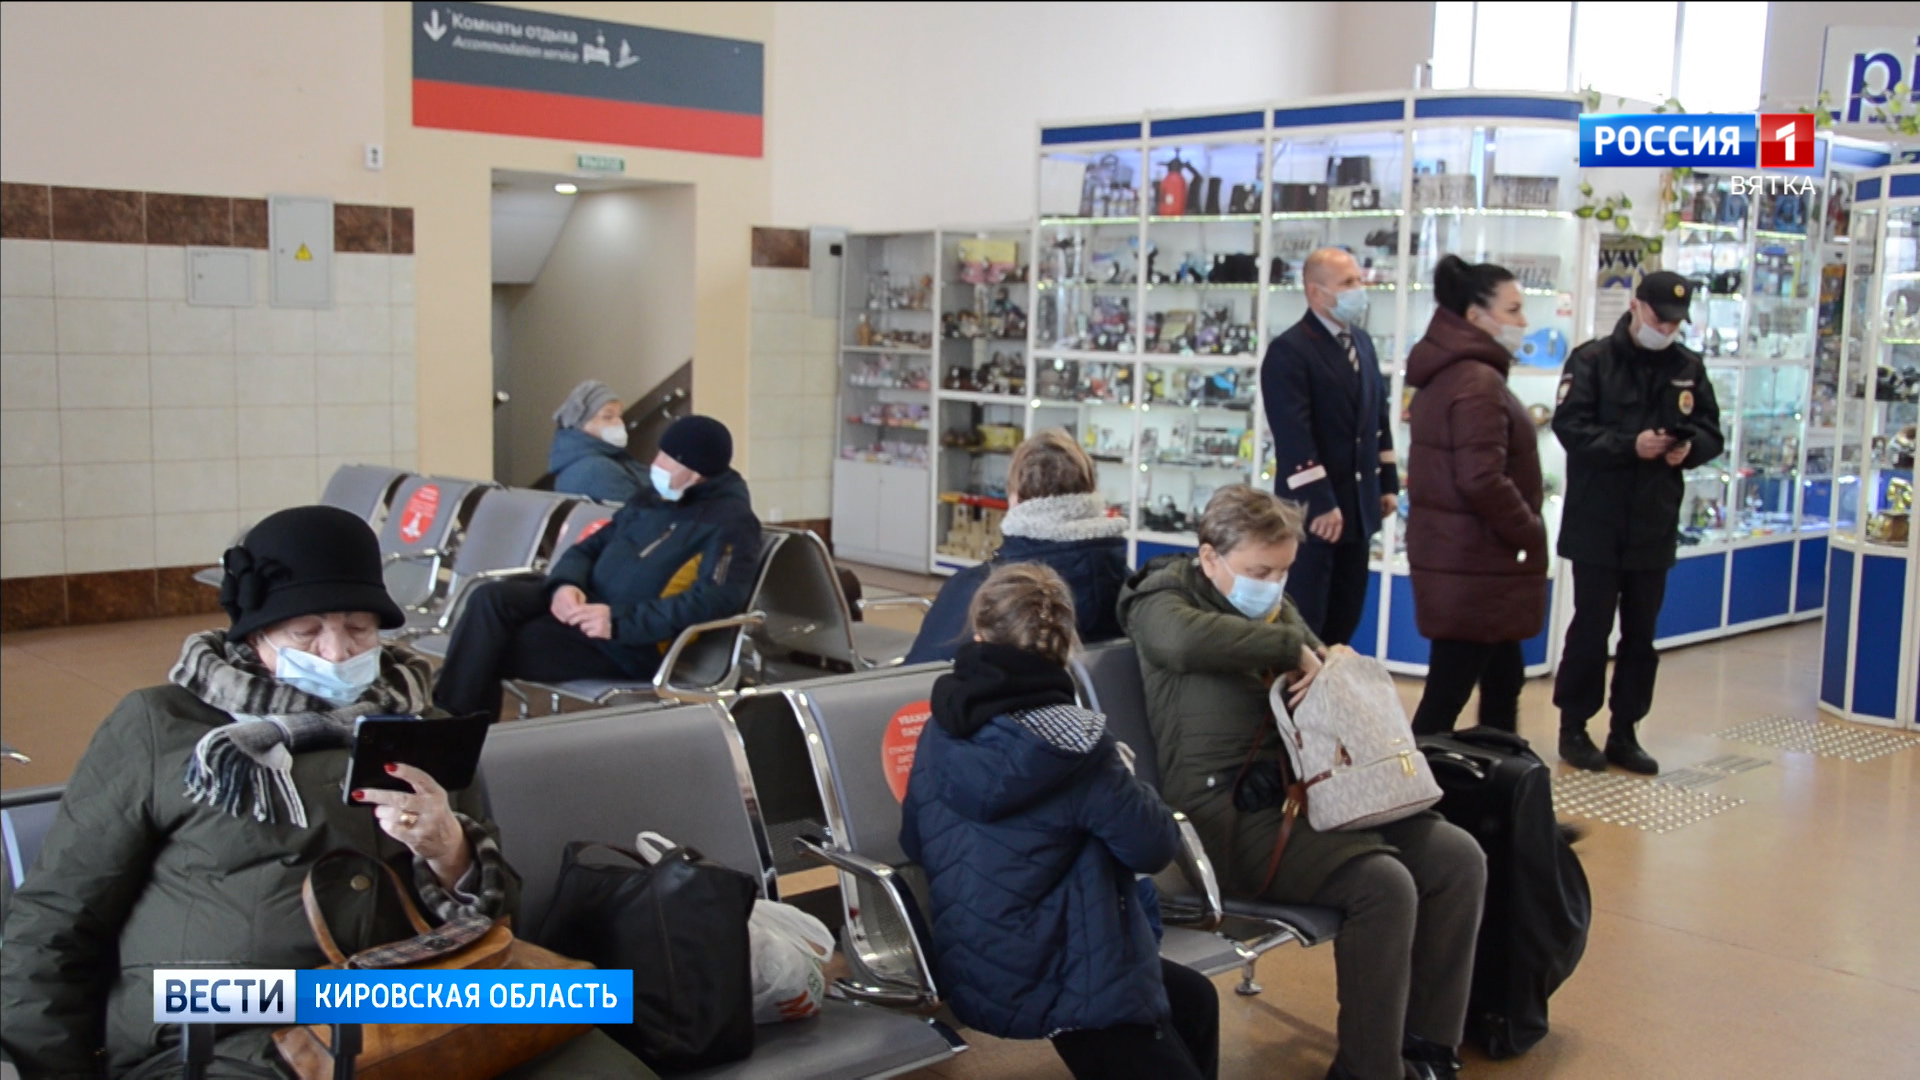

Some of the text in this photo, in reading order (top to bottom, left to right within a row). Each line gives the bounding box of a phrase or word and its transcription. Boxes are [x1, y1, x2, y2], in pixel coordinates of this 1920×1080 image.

[452, 13, 578, 44] Комнаты отдыха
[452, 35, 579, 64] Accommodation service
